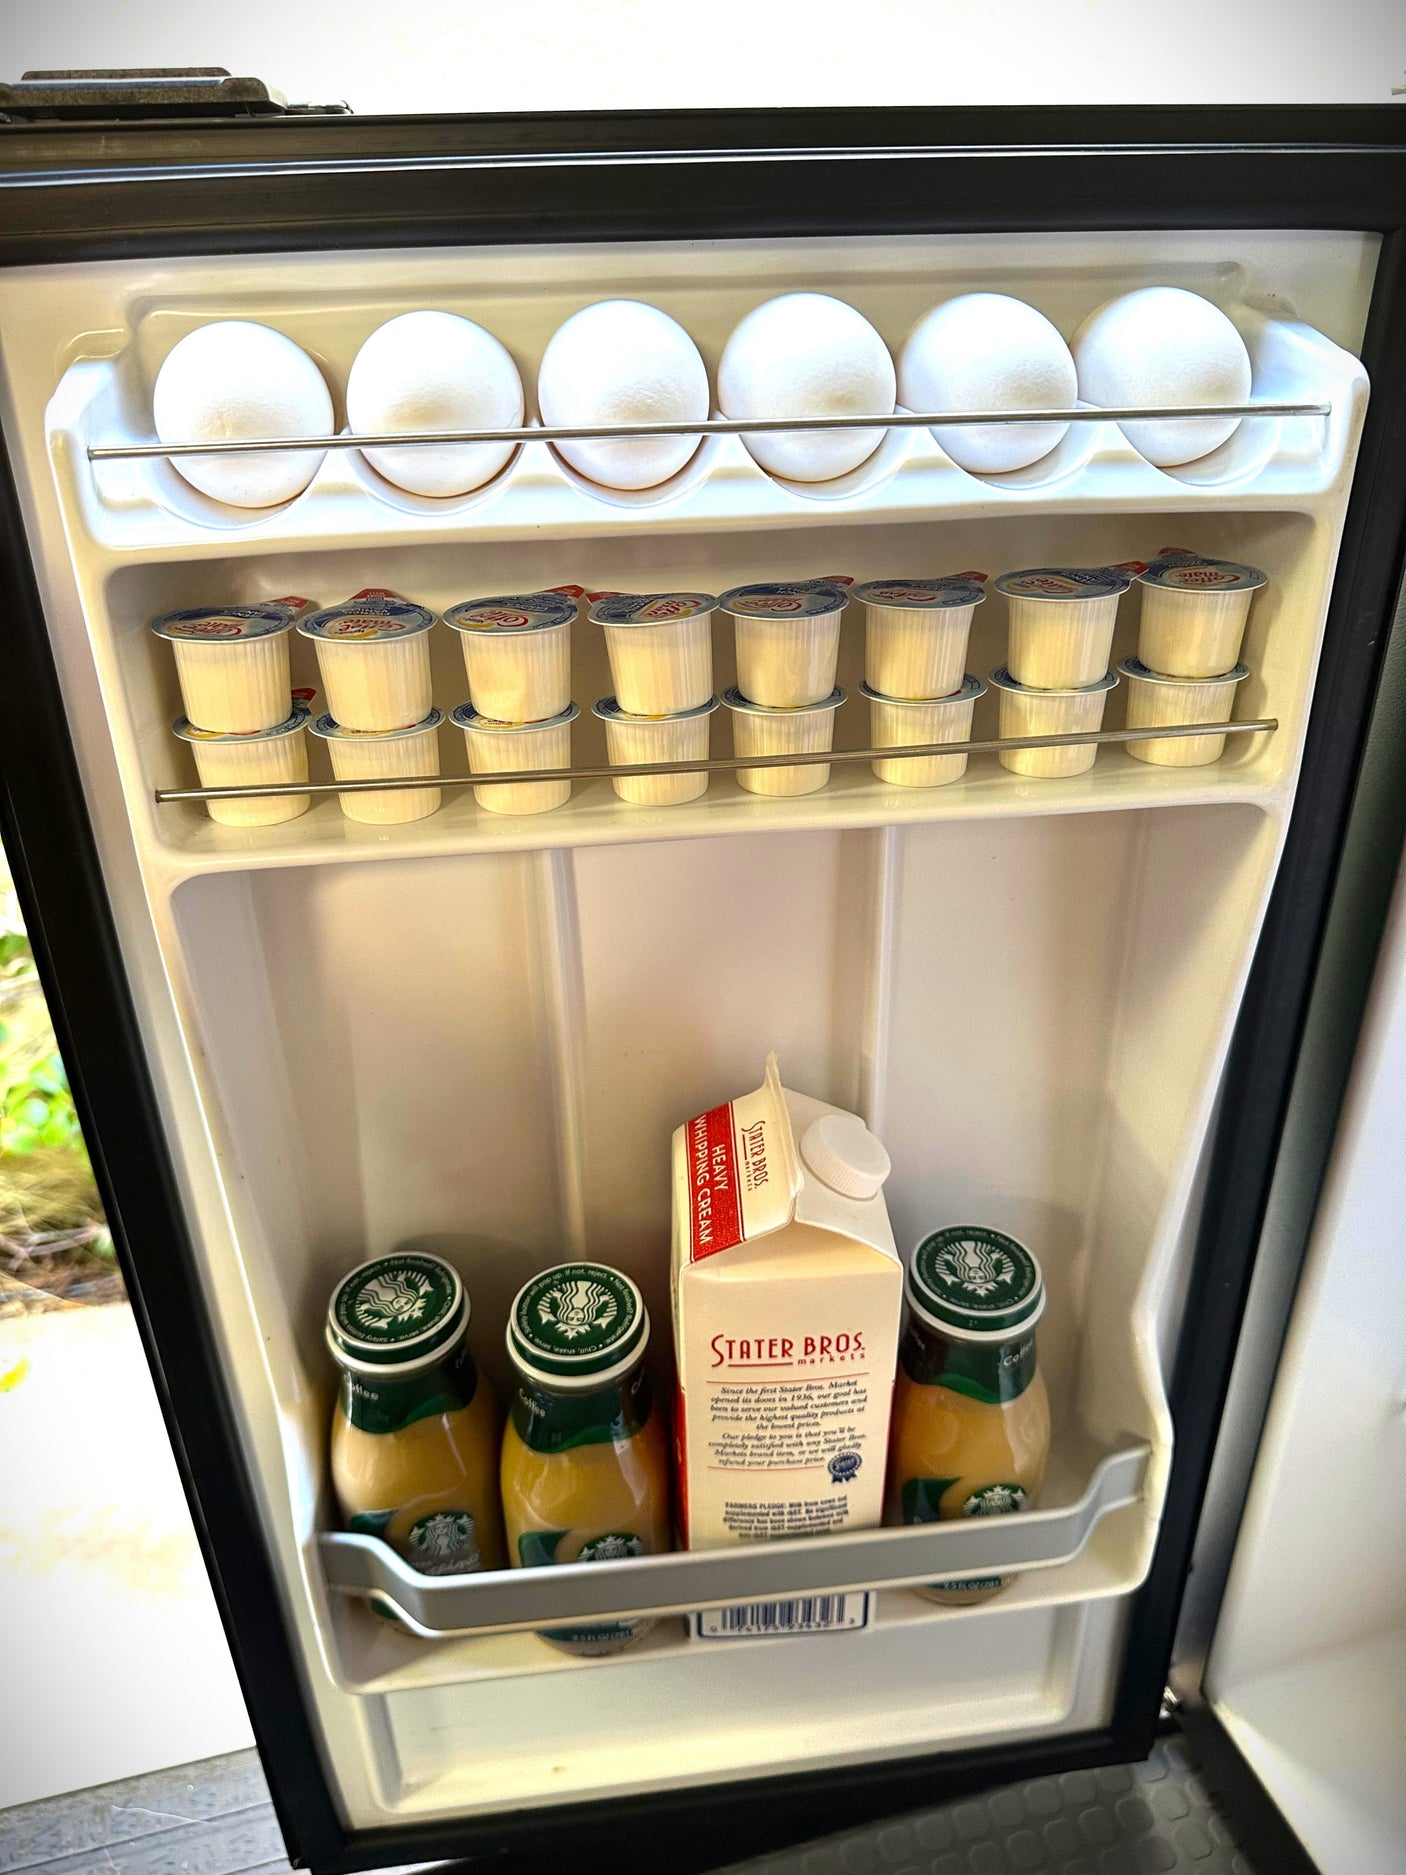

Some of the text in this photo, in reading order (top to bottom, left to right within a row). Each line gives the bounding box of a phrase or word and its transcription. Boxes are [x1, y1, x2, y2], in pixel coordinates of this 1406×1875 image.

[741, 1120, 766, 1158] STATER
[712, 1144, 729, 1191] HEAVY
[694, 1114, 713, 1245] WHIPPING CREAM
[745, 1160, 753, 1192] markets
[710, 1331, 866, 1368] STATER BROS.
[797, 1352, 866, 1366] markets
[721, 1386, 744, 1395] Since
[745, 1386, 758, 1394] the
[759, 1386, 777, 1396] first
[778, 1385, 803, 1393] Stater
[828, 1380, 858, 1389] Market
[519, 1387, 546, 1418] Coffee
[710, 1396, 740, 1404] opened
[791, 1393, 814, 1401] 1936,
[833, 1389, 851, 1399] goal
[710, 1404, 728, 1412] been
[780, 1403, 808, 1411] valued
[810, 1400, 849, 1409] customers
[851, 1395, 868, 1403] and
[711, 1413, 743, 1422] provide
[759, 1413, 788, 1423] highest
[790, 1411, 818, 1421] quality
[820, 1408, 855, 1419] products
[771, 1422, 795, 1430] lowest
[708, 1441, 749, 1450] completely
[750, 1441, 784, 1450] satisfied
[786, 1440, 804, 1448] with
[805, 1439, 821, 1447] any
[823, 1436, 847, 1444] Stater
[722, 1432, 740, 1440] Our
[741, 1433, 767, 1441] pledge
[778, 1433, 793, 1441] you
[804, 1430, 821, 1438] that
[714, 1449, 747, 1457] Markets
[748, 1449, 774, 1457] brand
[821, 1445, 836, 1453] will
[837, 1442, 862, 1452] gladly
[718, 1457, 746, 1466] refund
[746, 1458, 765, 1467] your
[766, 1457, 802, 1467] purchase
